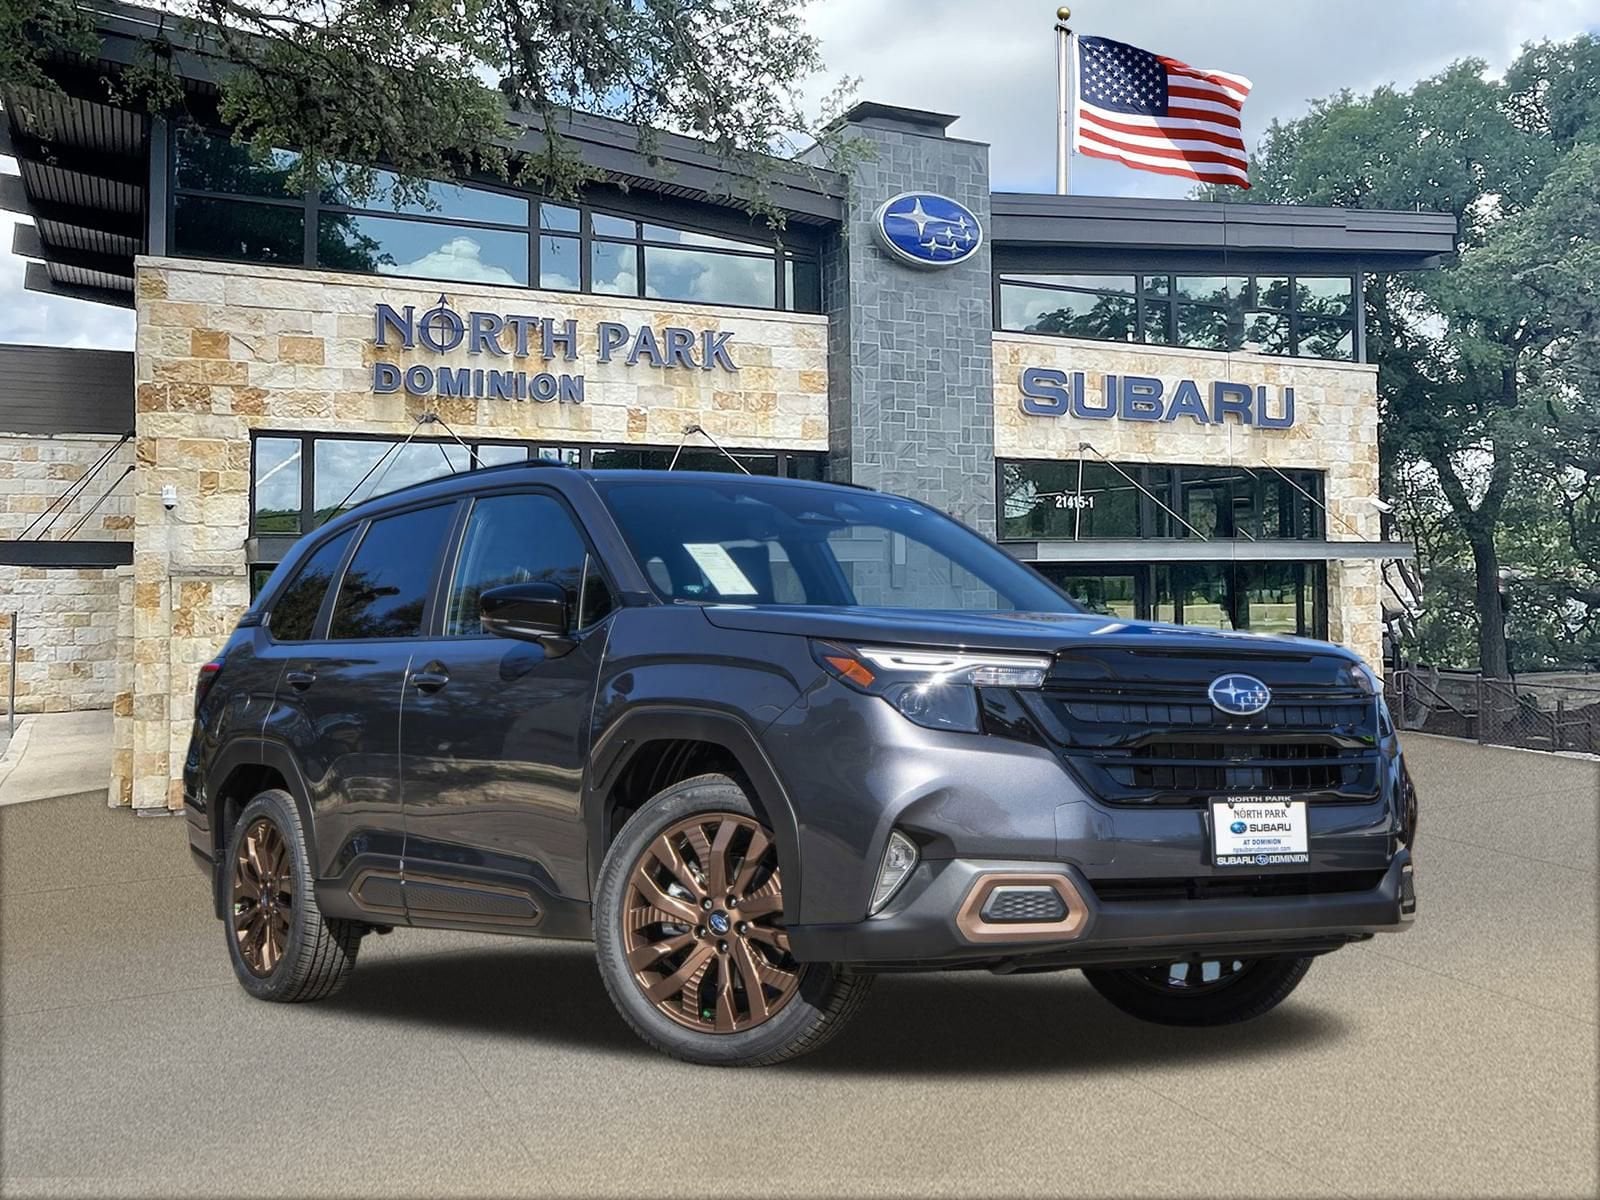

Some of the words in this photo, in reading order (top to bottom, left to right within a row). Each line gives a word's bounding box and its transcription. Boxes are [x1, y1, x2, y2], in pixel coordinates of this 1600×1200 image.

[374, 294, 580, 361] NORTH
[597, 321, 742, 373] PARK
[373, 362, 585, 404] DOMINION
[1018, 367, 1295, 430] SUBARU
[1233, 808, 1263, 819] NORTH
[1264, 809, 1288, 818] PARK
[1249, 823, 1292, 832] SUBARU
[1217, 856, 1255, 865] SUBARU
[1269, 854, 1309, 863] DOMINION
